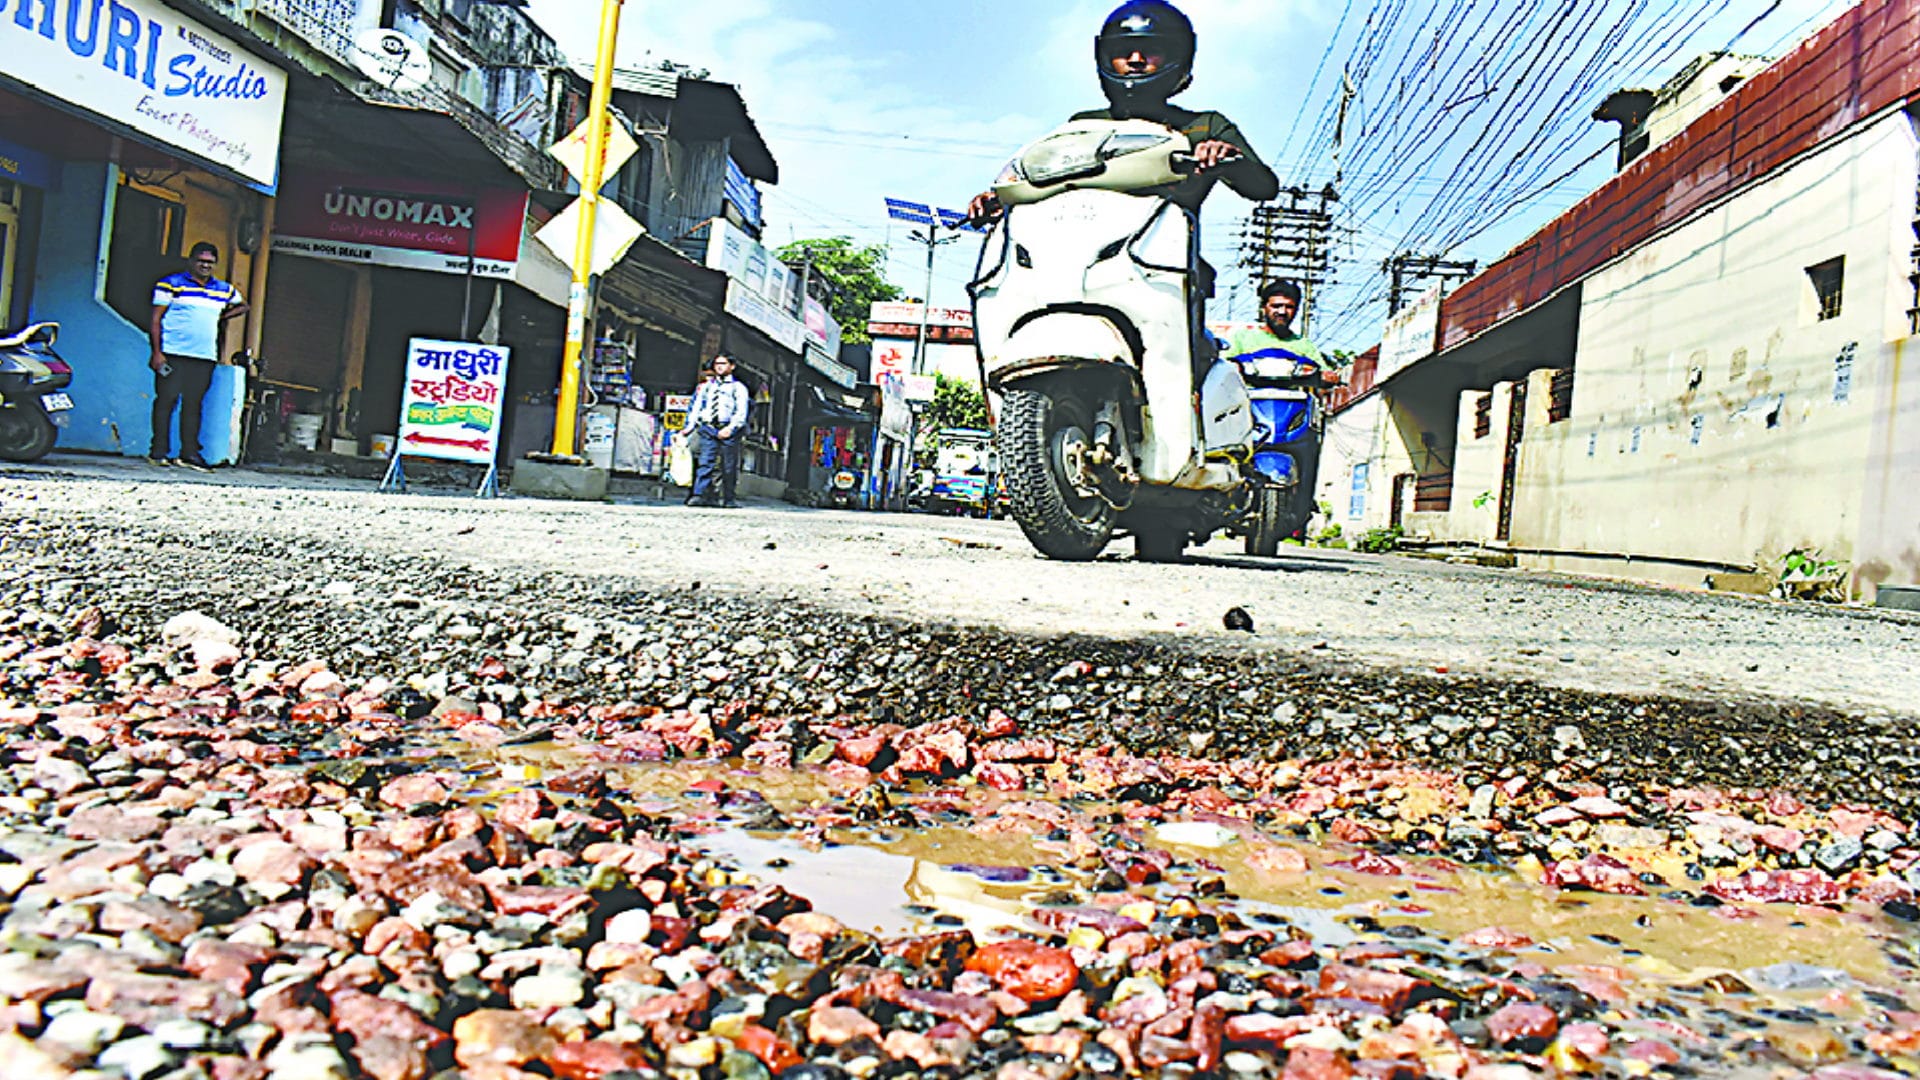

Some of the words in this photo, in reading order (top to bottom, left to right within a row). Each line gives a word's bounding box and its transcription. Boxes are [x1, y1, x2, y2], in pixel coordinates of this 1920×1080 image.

[164, 53, 268, 100] Studio
[135, 95, 177, 125] Event
[179, 113, 251, 165] Photography
[324, 191, 474, 229] UNOMAX
[416, 348, 502, 381] माधुरी
